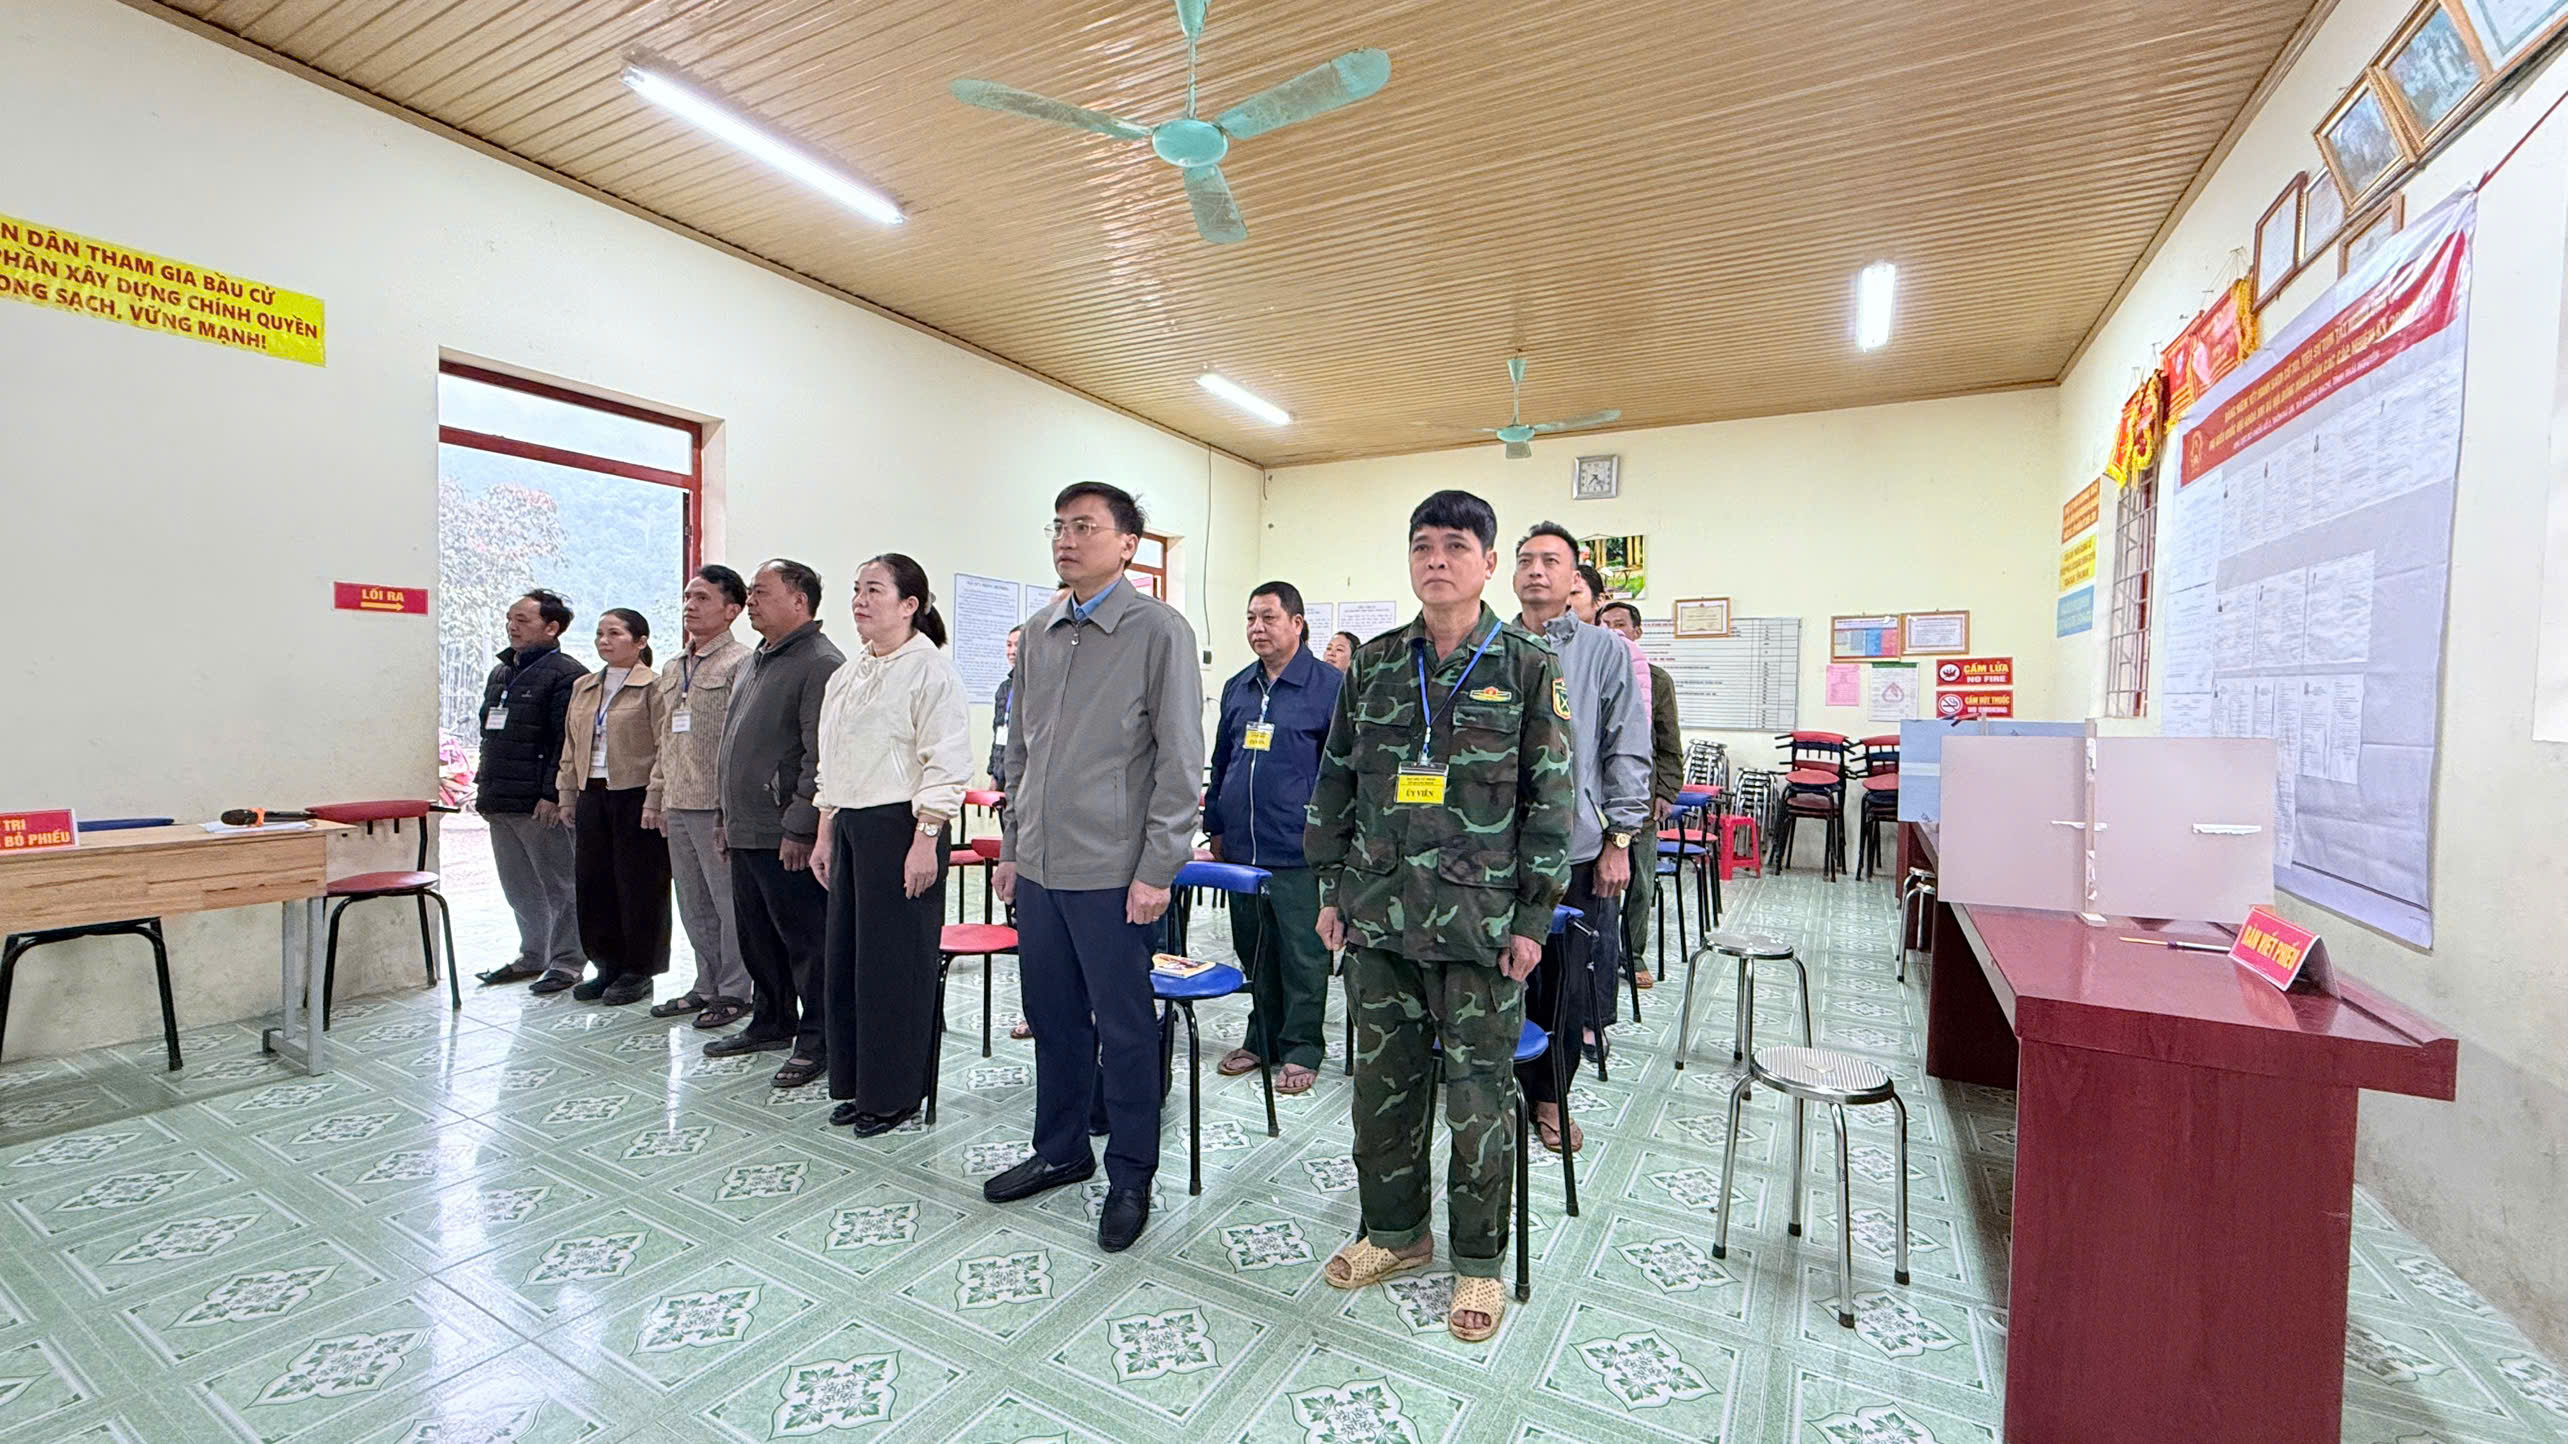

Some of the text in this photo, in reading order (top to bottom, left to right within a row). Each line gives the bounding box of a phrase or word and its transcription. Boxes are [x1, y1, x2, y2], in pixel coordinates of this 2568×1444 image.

[27, 229, 79, 257] DÂN
[86, 244, 154, 276] THAM
[161, 265, 197, 287] GIA
[203, 271, 243, 298] BẦU
[250, 286, 276, 305] CỬ
[66, 265, 109, 289] XÂY
[117, 277, 181, 306] DỰNG
[188, 295, 251, 323] CHÍNH
[257, 312, 318, 339] QUYỀN
[130, 304, 192, 332] VỮNG
[198, 319, 267, 349] MẠNH!
[362, 586, 405, 602] LỐI RA
[1963, 661, 2009, 673] CẤM LỬA
[1983, 675, 2006, 683] FIRE
[3, 818, 26, 832] TRI
[4, 831, 25, 848] BỎ
[28, 827, 71, 846] PHIẾU
[2256, 930, 2280, 958] VIẾT
[2271, 941, 2301, 971] PHIẾU
